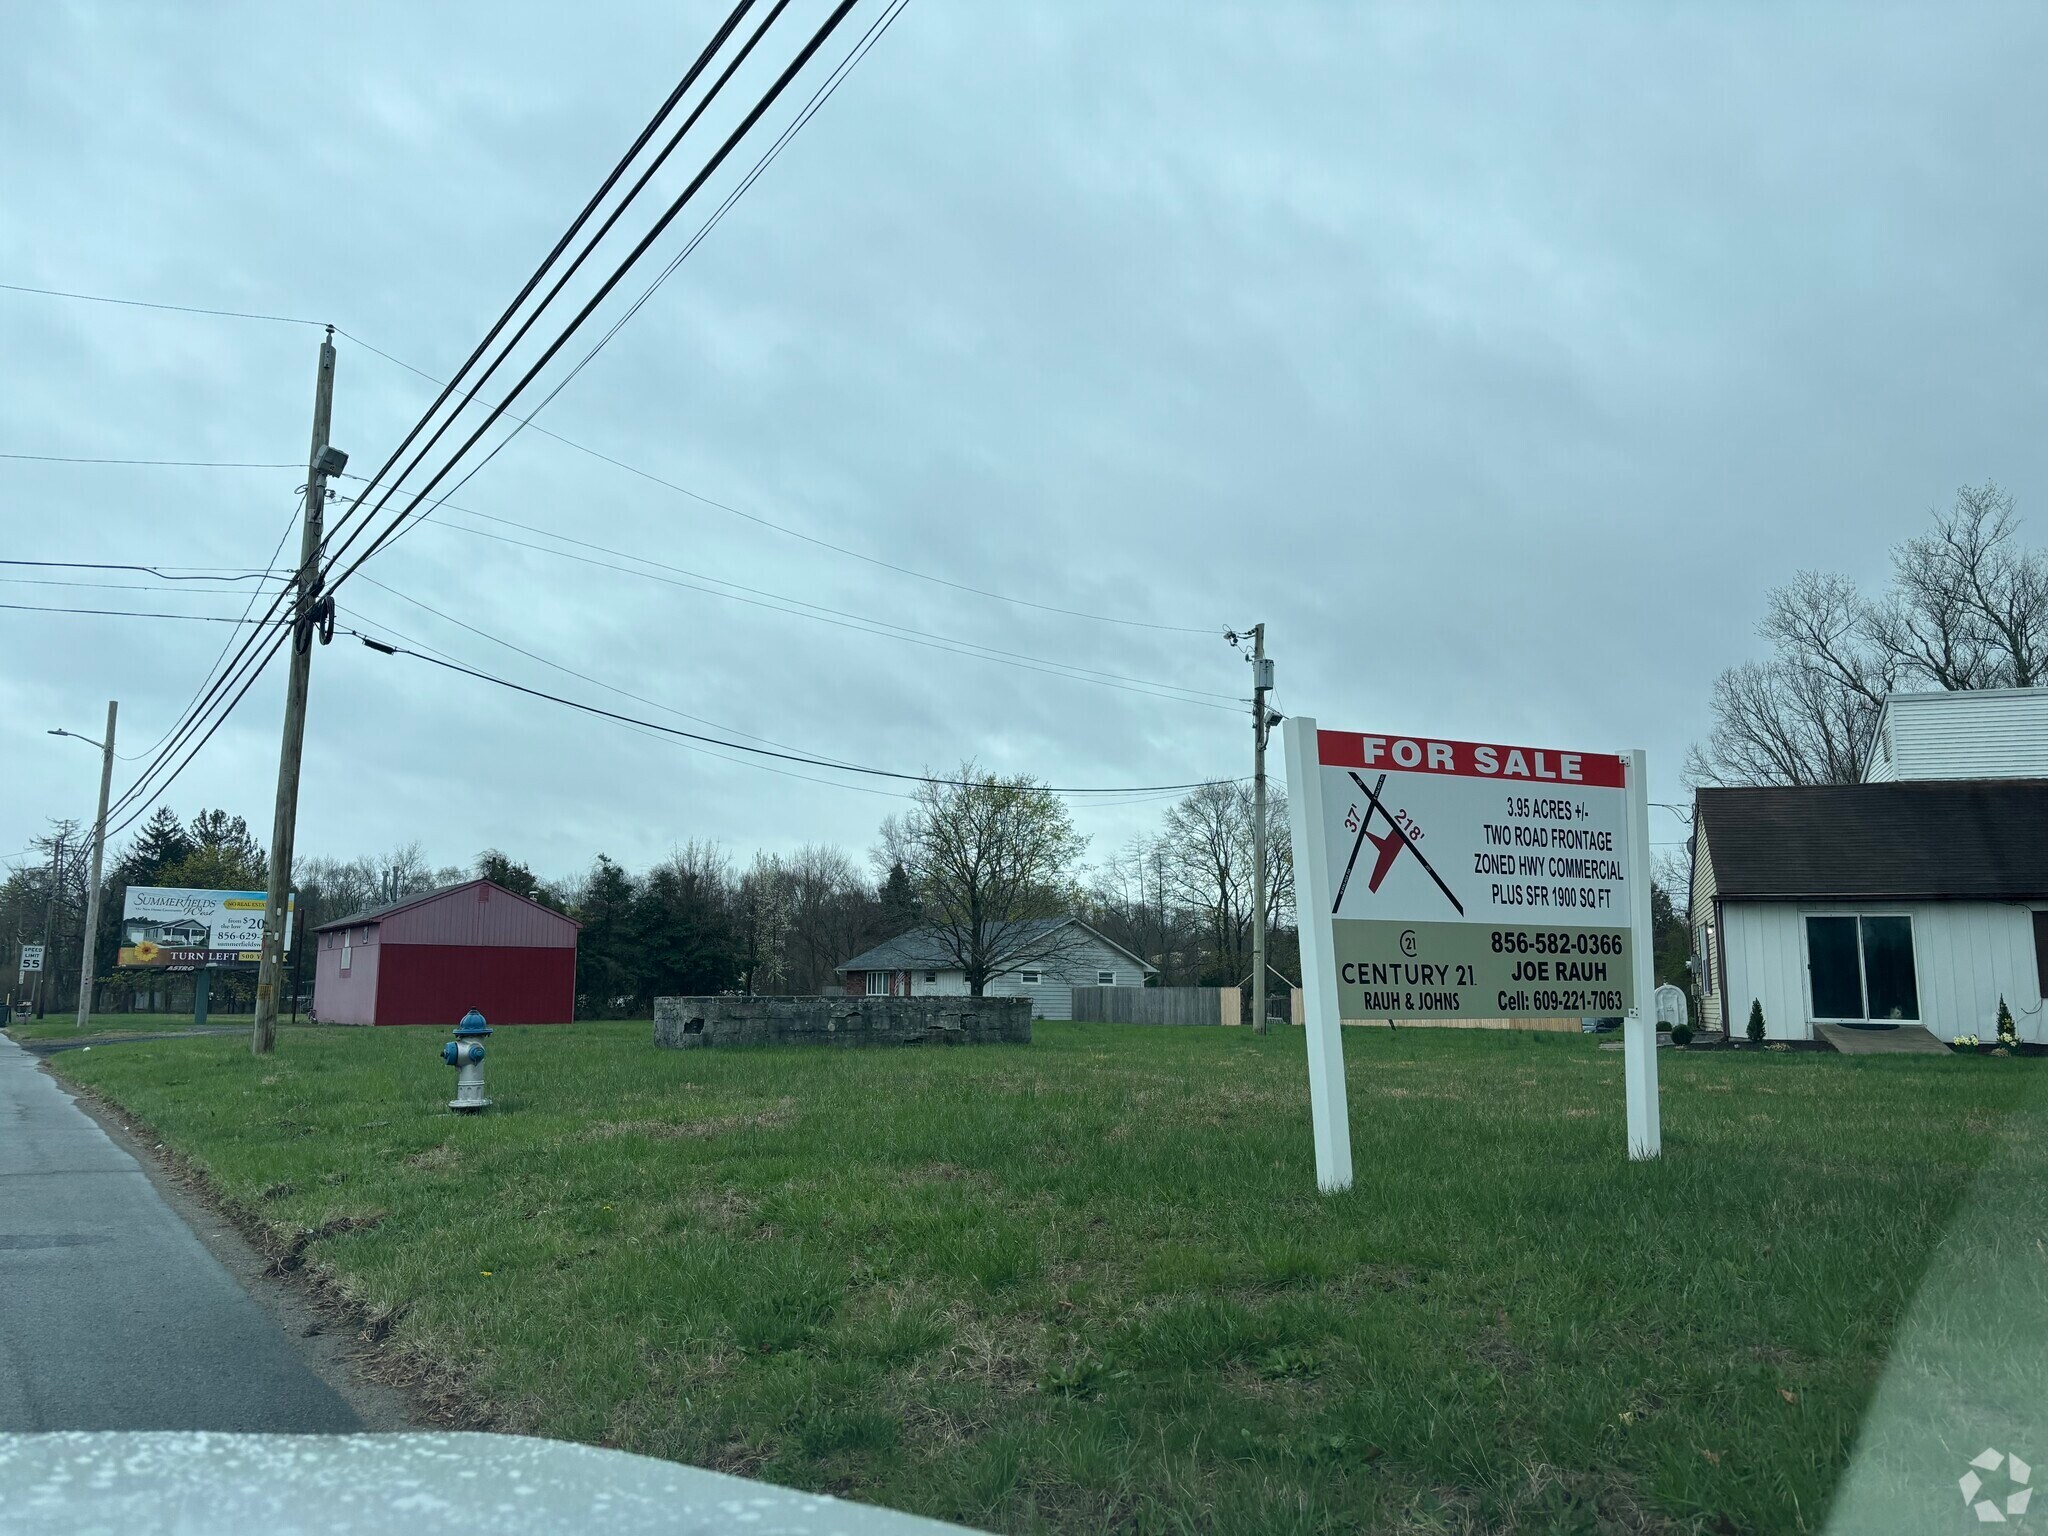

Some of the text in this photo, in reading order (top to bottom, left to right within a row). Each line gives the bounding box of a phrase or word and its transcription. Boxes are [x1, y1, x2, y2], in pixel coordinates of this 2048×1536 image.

[1362, 736, 1584, 781] FOR SALE
[1343, 802, 1361, 834] 37'
[1506, 796, 1589, 822] 3.95 ACRES +/-
[1394, 807, 1426, 842] 218'
[1483, 824, 1613, 852] TWO ROAD FRONTAGE
[1474, 853, 1624, 881] ZONED HWY COMMERCIAL
[1491, 883, 1612, 909] PLUS SFR 1900 SQ FT
[242, 916, 264, 930] $20
[217, 931, 261, 941] 856-629-
[1490, 931, 1623, 955] 856-582-0366
[23, 959, 39, 968] 55
[170, 951, 205, 961] TURN
[209, 952, 238, 961] LEFT
[1341, 962, 1449, 986] CENTURY
[1511, 960, 1607, 982] JOE RAUH
[1364, 991, 1460, 1011] RAUH & JOHNS
[1497, 990, 1623, 1011] Cell: 609-221-7063
